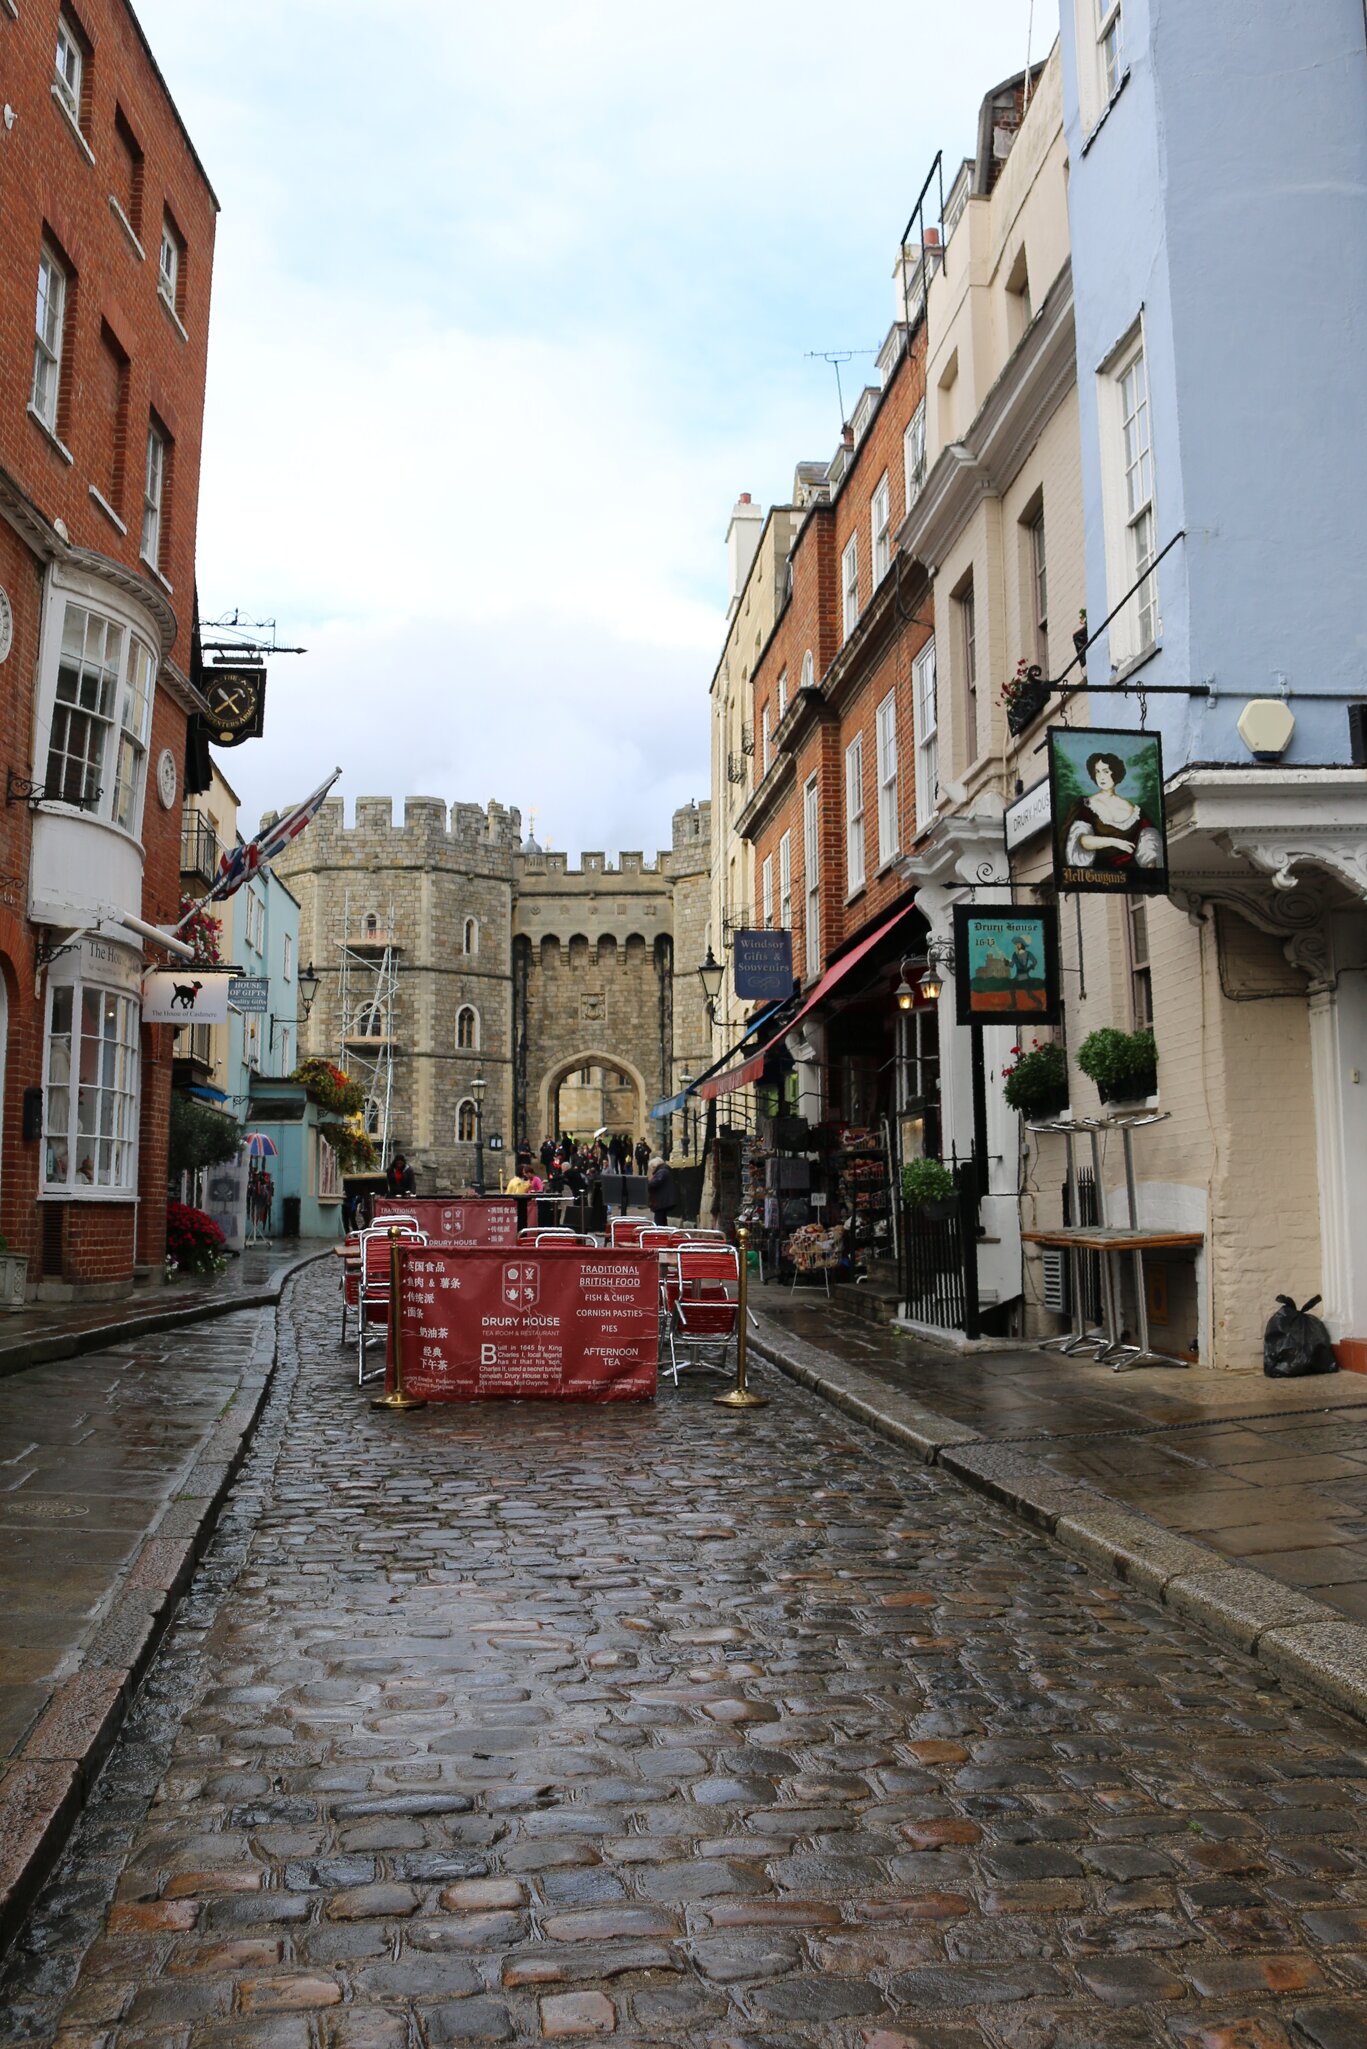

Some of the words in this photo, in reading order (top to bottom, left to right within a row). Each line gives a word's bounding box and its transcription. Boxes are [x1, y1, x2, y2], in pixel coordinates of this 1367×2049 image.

[1013, 808, 1032, 832] DRURY
[1034, 793, 1050, 813] HOUS
[1063, 868, 1084, 884] Nell
[974, 922, 1003, 933] Drury
[1006, 922, 1038, 932] House
[740, 939, 785, 949] Windsor
[975, 938, 995, 947] 1645
[88, 941, 106, 960] The
[743, 951, 768, 961] Gifts
[773, 952, 782, 961] &
[738, 962, 790, 972] Souvenirs
[234, 981, 262, 989] HOUSE
[189, 1010, 217, 1018] Cashmere
[580, 1264, 640, 1274] TRADITIONAL
[428, 1278, 436, 1288] &
[440, 1277, 462, 1289] 薯条
[579, 1277, 613, 1286] BRITISH
[615, 1278, 641, 1287] FOOD
[585, 1294, 602, 1302] FISH
[603, 1294, 610, 1302] &
[611, 1294, 635, 1302] CHIPS
[576, 1309, 611, 1317] CORNISH
[613, 1309, 643, 1318] PASTIES
[481, 1317, 520, 1326] DRURY
[522, 1317, 561, 1326] HOUSE
[419, 1327, 449, 1339] 奶油茶
[601, 1324, 618, 1333] PIES
[423, 1346, 442, 1358] 经典
[537, 1344, 545, 1352] by
[548, 1344, 563, 1352] King
[583, 1347, 639, 1356] AFTERNOON
[420, 1358, 448, 1370] 下午茶
[602, 1357, 621, 1366] TEA
